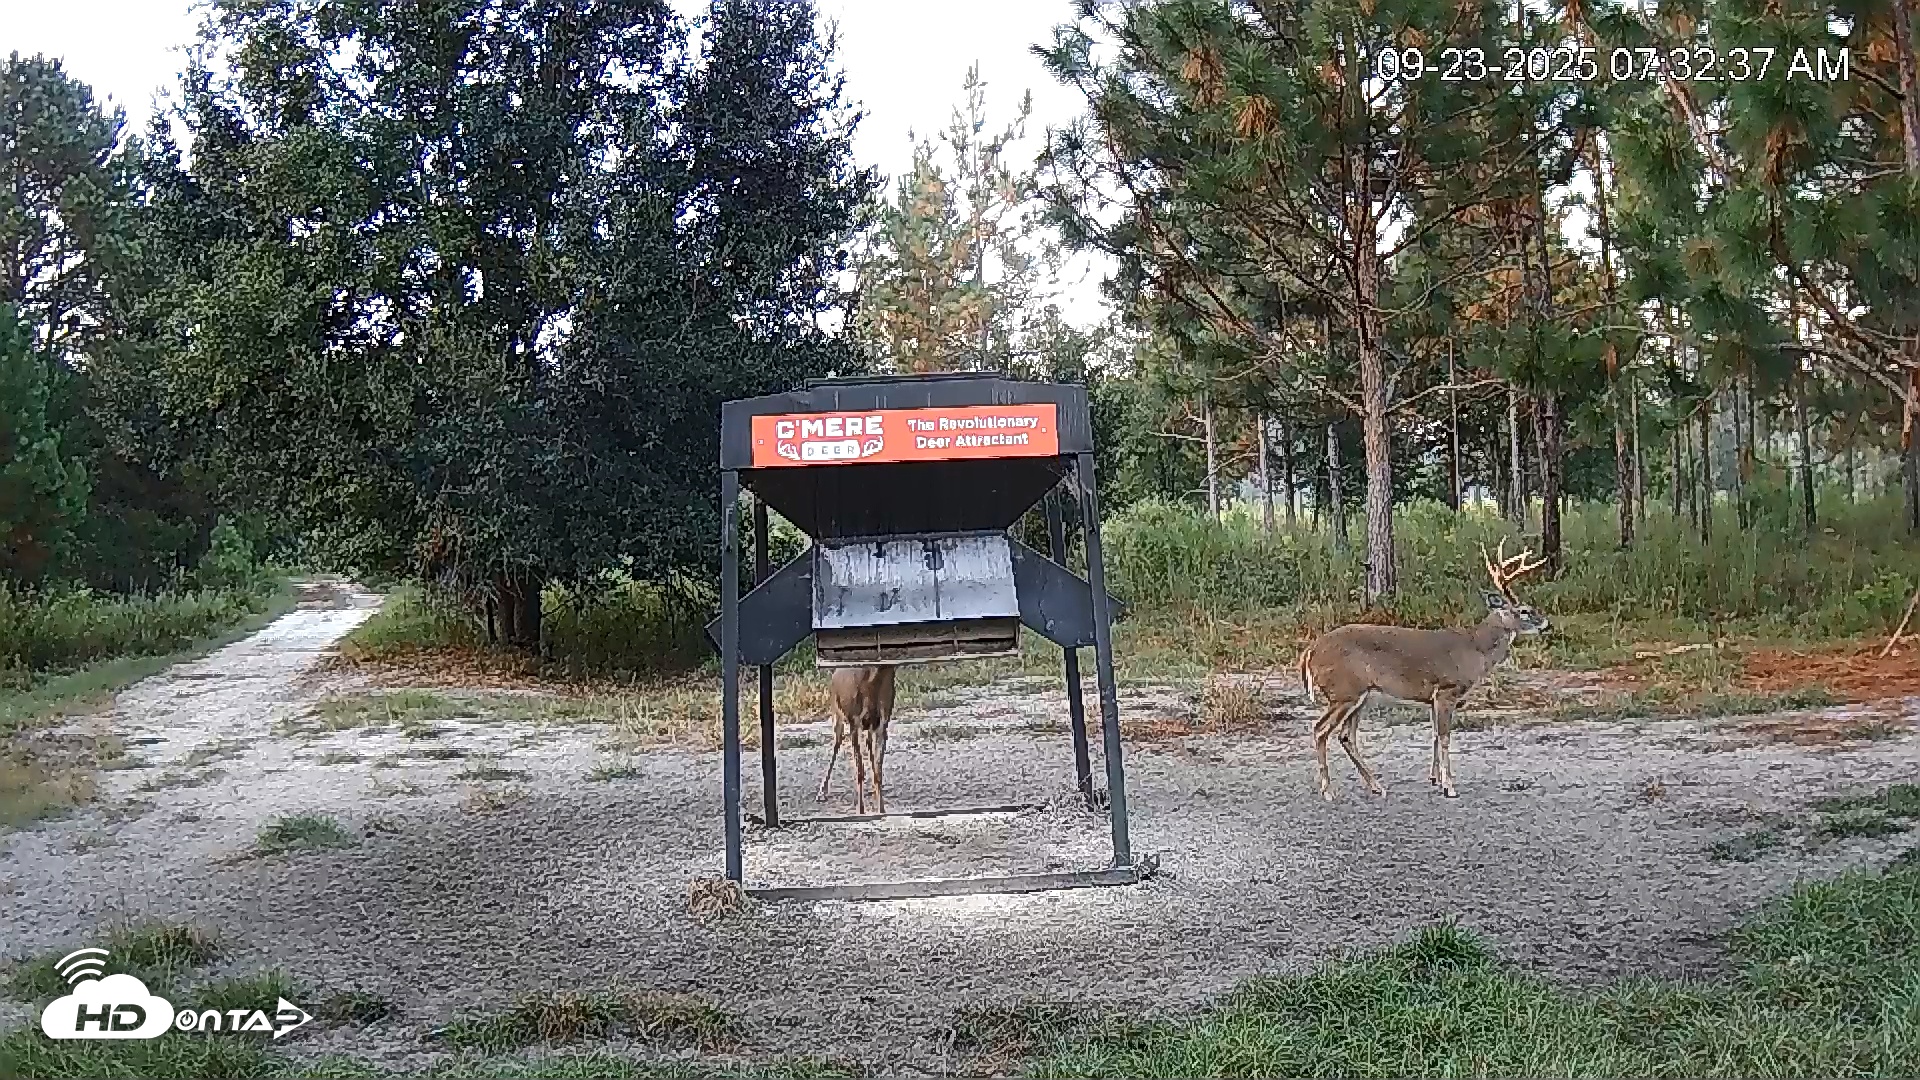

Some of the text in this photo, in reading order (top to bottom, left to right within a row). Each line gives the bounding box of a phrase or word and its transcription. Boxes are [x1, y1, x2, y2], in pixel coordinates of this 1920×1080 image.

[776, 415, 884, 438] C'MERE
[907, 415, 1039, 431] The Revolutionary
[916, 433, 1029, 449] Deer Attractant
[807, 444, 856, 458] DEER
